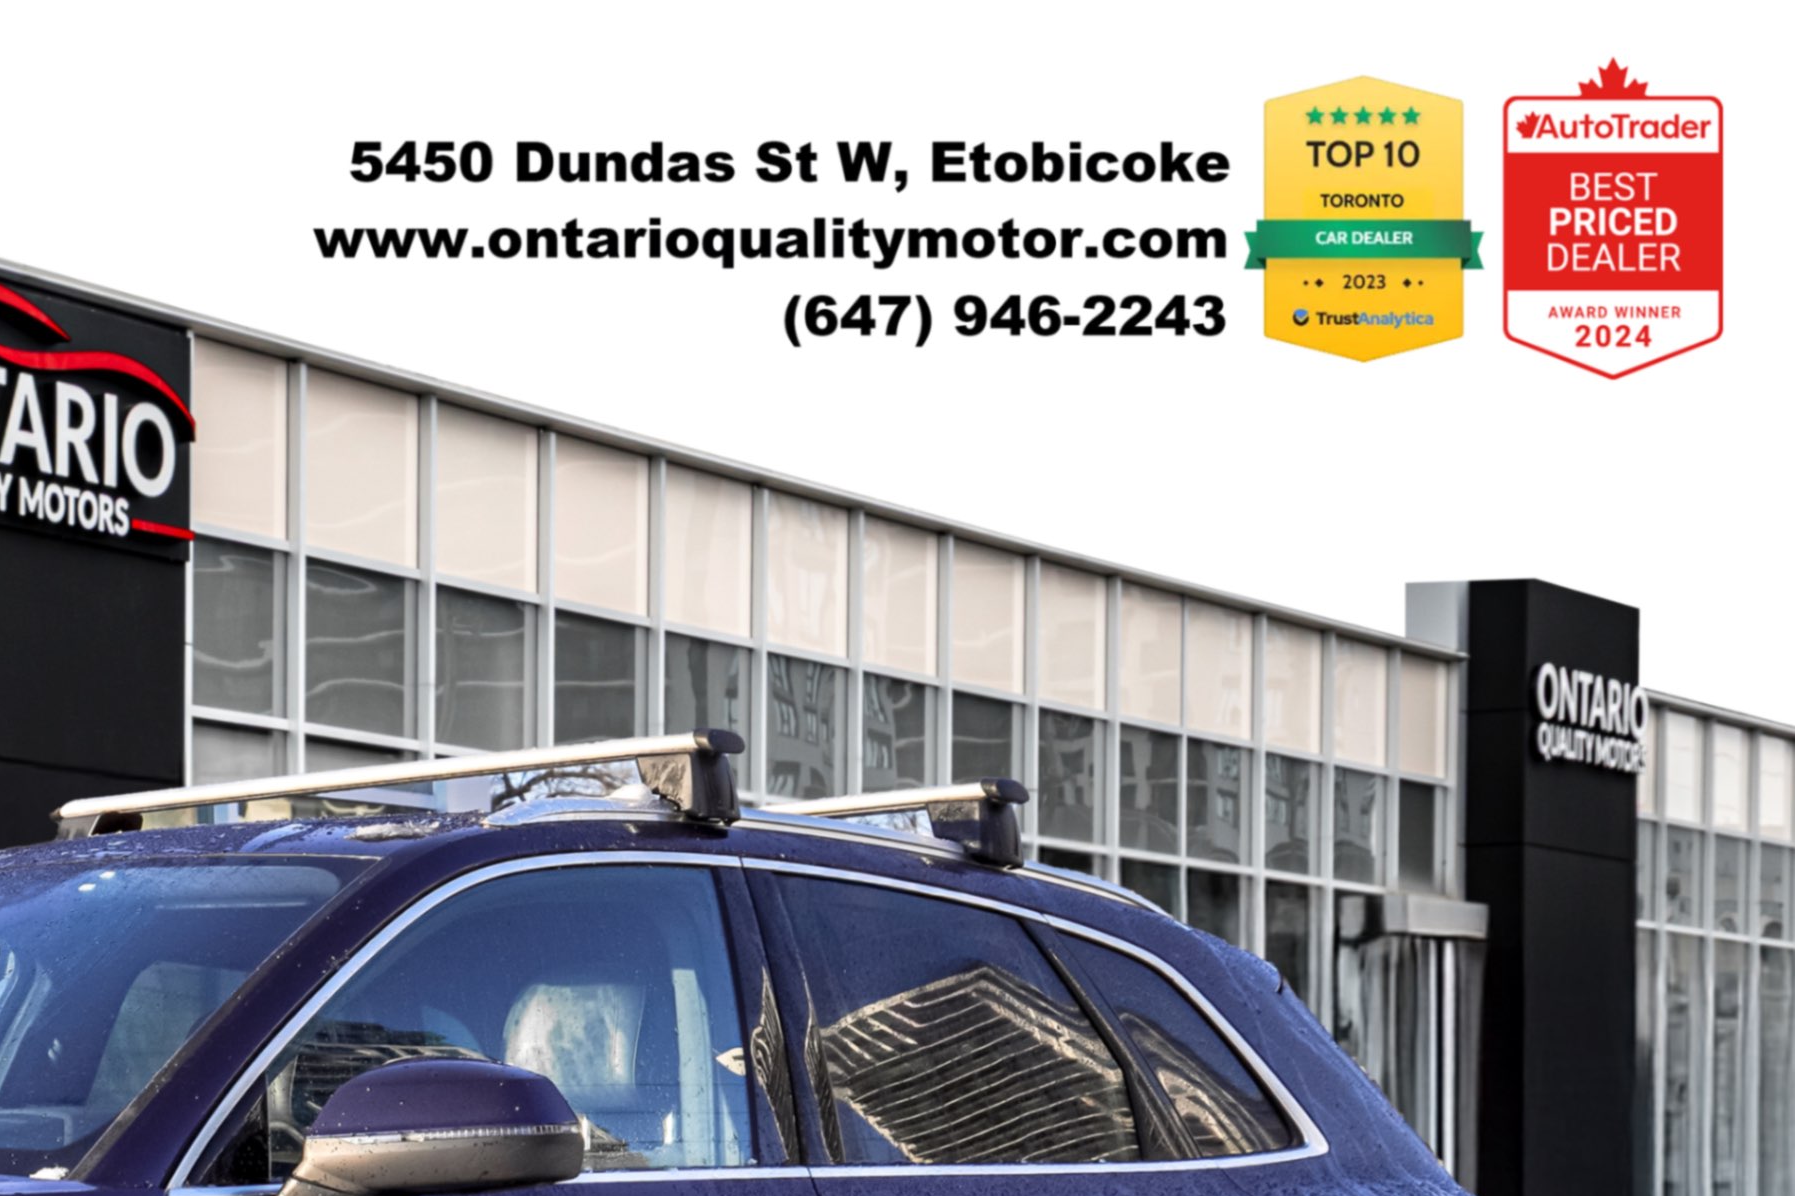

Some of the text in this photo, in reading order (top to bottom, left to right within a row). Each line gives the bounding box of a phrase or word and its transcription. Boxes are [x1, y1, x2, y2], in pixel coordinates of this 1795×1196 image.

[18, 475, 130, 537] MOTORS
[1537, 662, 1649, 738] ONTARIO
[1537, 722, 1648, 774] QUALITY MOTORS
